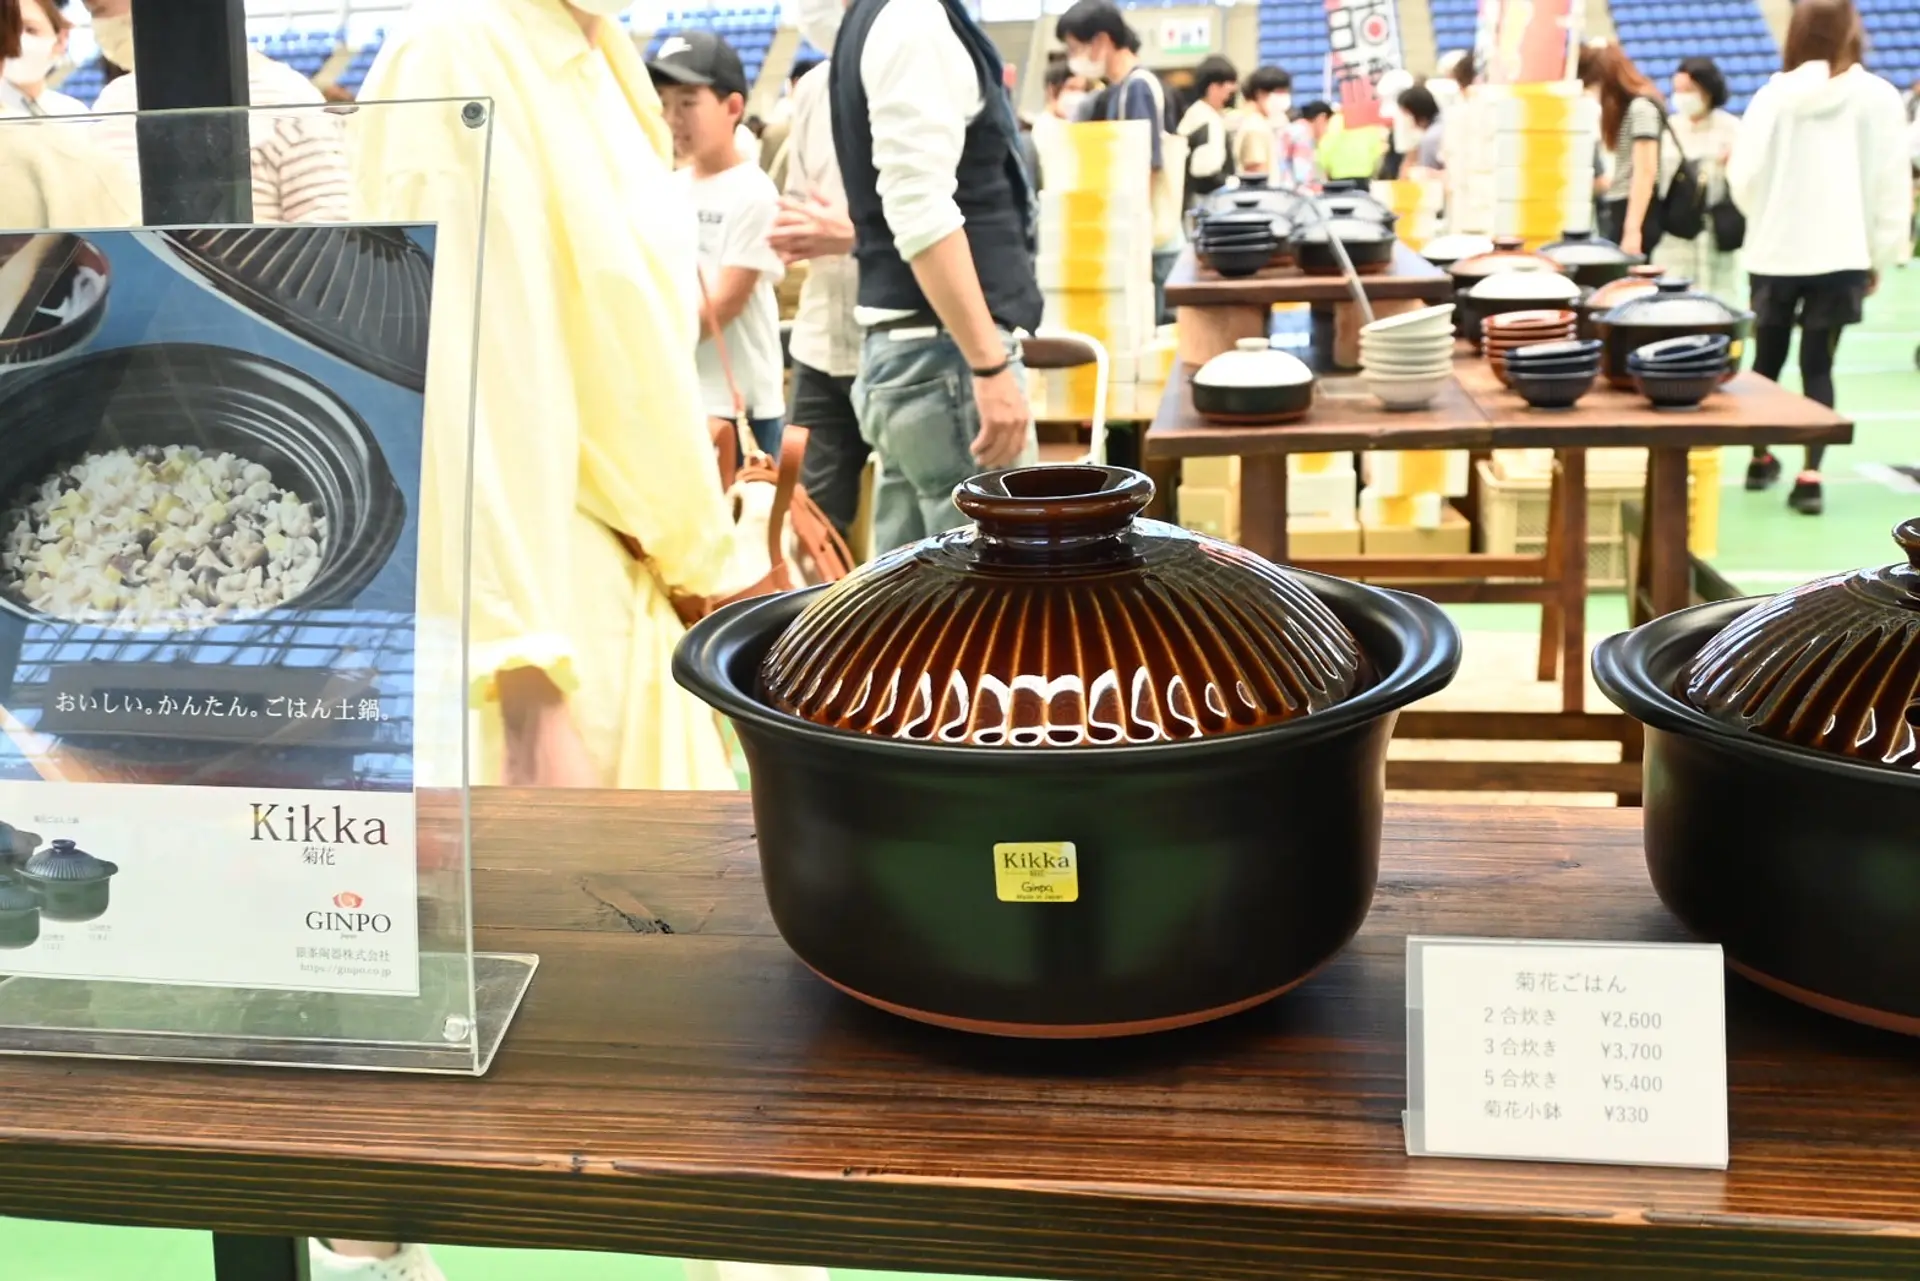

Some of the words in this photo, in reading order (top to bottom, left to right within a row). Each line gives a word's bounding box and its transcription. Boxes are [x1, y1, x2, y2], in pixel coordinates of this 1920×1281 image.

[249, 803, 388, 845] Kikka
[302, 846, 336, 866] 菊花
[1004, 852, 1070, 868] Kikka
[305, 910, 392, 933] GINPO
[1515, 971, 1627, 993] 菊花ごはん
[1600, 1011, 1662, 1029] ¥2,600
[1600, 1042, 1662, 1060] ¥3,700
[1600, 1074, 1663, 1092] ¥5,400
[1604, 1105, 1649, 1123] ¥330
